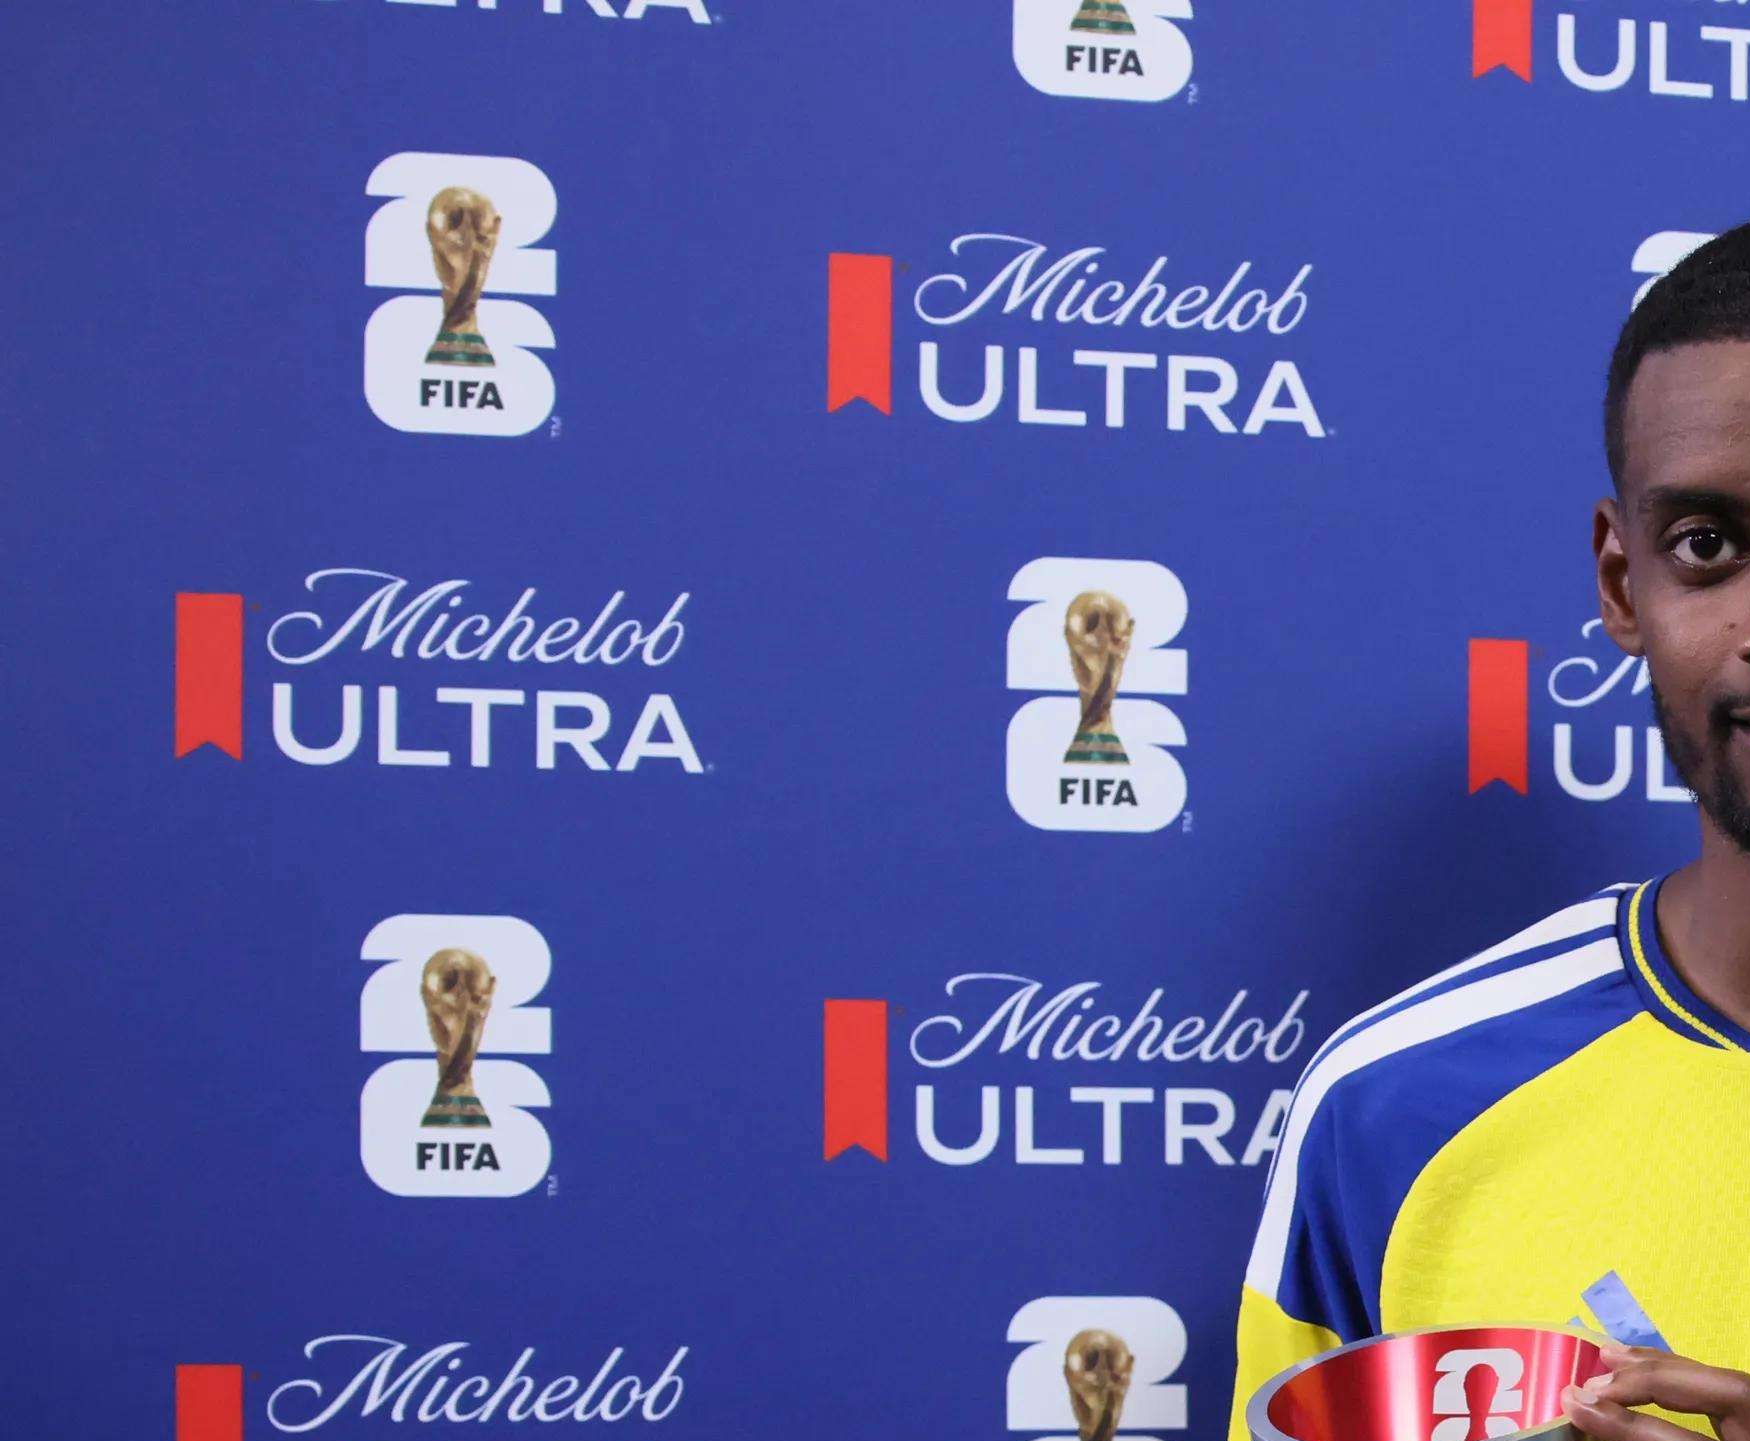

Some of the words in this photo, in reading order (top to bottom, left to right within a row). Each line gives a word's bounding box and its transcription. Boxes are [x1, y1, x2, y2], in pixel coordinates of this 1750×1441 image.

[1066, 45, 1144, 76] FIFA
[914, 234, 1312, 334] Michelob
[420, 378, 504, 410] FIFA
[920, 342, 1325, 437] ULTRA
[267, 568, 689, 666] Michelob
[273, 683, 704, 773] ULTRA
[1060, 778, 1138, 806] FIFA
[910, 973, 1309, 1067] Michelob
[416, 1142, 500, 1171] FIFA
[267, 1335, 688, 1432] Michelob
